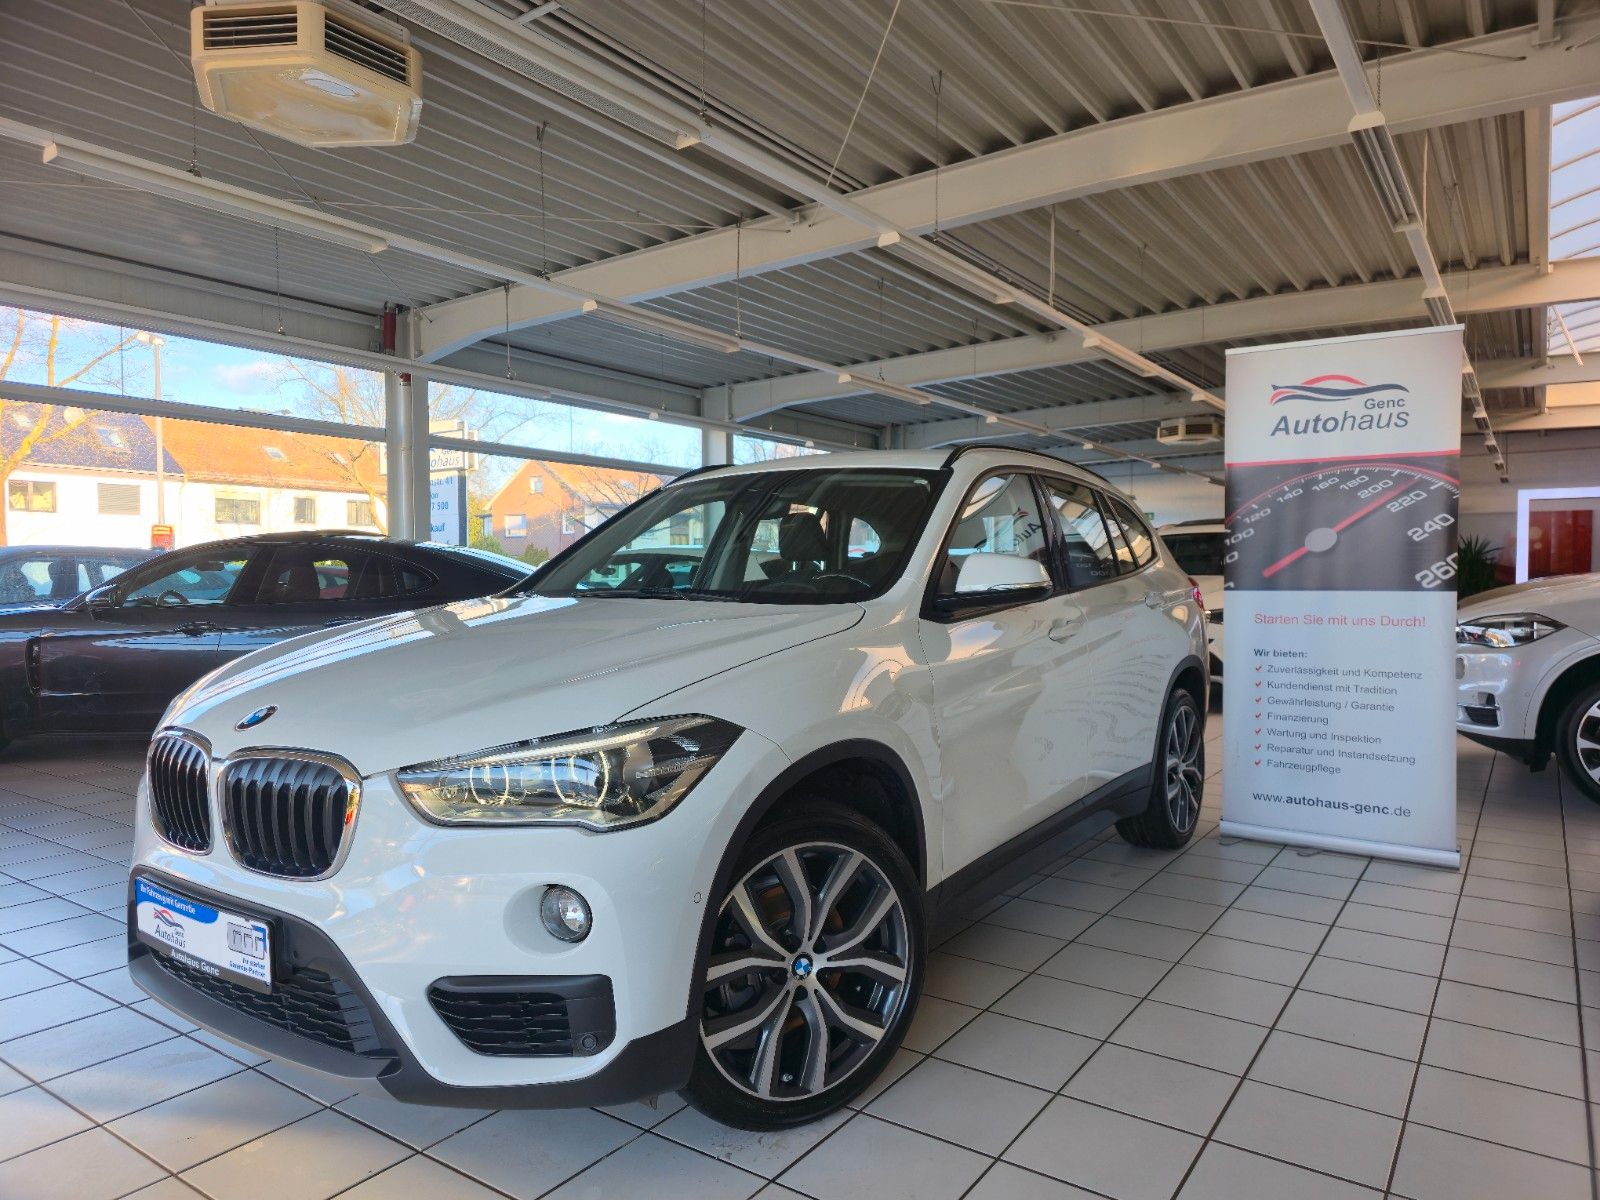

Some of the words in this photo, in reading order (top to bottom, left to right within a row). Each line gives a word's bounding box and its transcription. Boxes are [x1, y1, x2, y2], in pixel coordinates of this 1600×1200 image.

[1364, 398, 1406, 410] Genc
[1270, 410, 1410, 437] Autohaus
[431, 455, 460, 468] ohaus
[1312, 476, 1340, 492] 160
[1339, 475, 1369, 491] 180
[1357, 479, 1393, 499] 200
[1277, 488, 1304, 503] 140
[1386, 490, 1428, 513] 220
[1242, 508, 1271, 524] 120
[1407, 513, 1455, 542] 240
[1224, 528, 1255, 546] 100
[1254, 613, 1299, 625] Starten
[1303, 614, 1324, 626] Sie
[1328, 615, 1348, 626] mit
[1352, 616, 1376, 627] uns
[1381, 615, 1426, 628] Durch!
[1253, 649, 1270, 657] Wir
[1273, 650, 1308, 659] bieten:
[1267, 665, 1339, 677] Zuverlässigkeit
[1342, 668, 1361, 677] und
[1364, 669, 1423, 681] Kompetenz
[1267, 681, 1333, 692] Kundendienst
[1336, 684, 1351, 693] mit
[1354, 685, 1398, 695] Tradition
[1267, 696, 1342, 710] Gewährleistung
[1351, 701, 1395, 712] Garantie
[1267, 712, 1329, 725] Finanzierung
[1267, 728, 1307, 740] Wartung
[1309, 731, 1328, 740] und
[1331, 732, 1382, 745] Inspektion
[1267, 744, 1315, 756] Reparatur
[1316, 747, 1335, 757] und
[1338, 749, 1416, 765] Instandsetzung
[1266, 759, 1341, 775] Fahrzeugpflege
[1252, 792, 1412, 818] www.autohaus-genc.de
[154, 924, 186, 948] Autohaus
[171, 949, 200, 969] Autohaus
